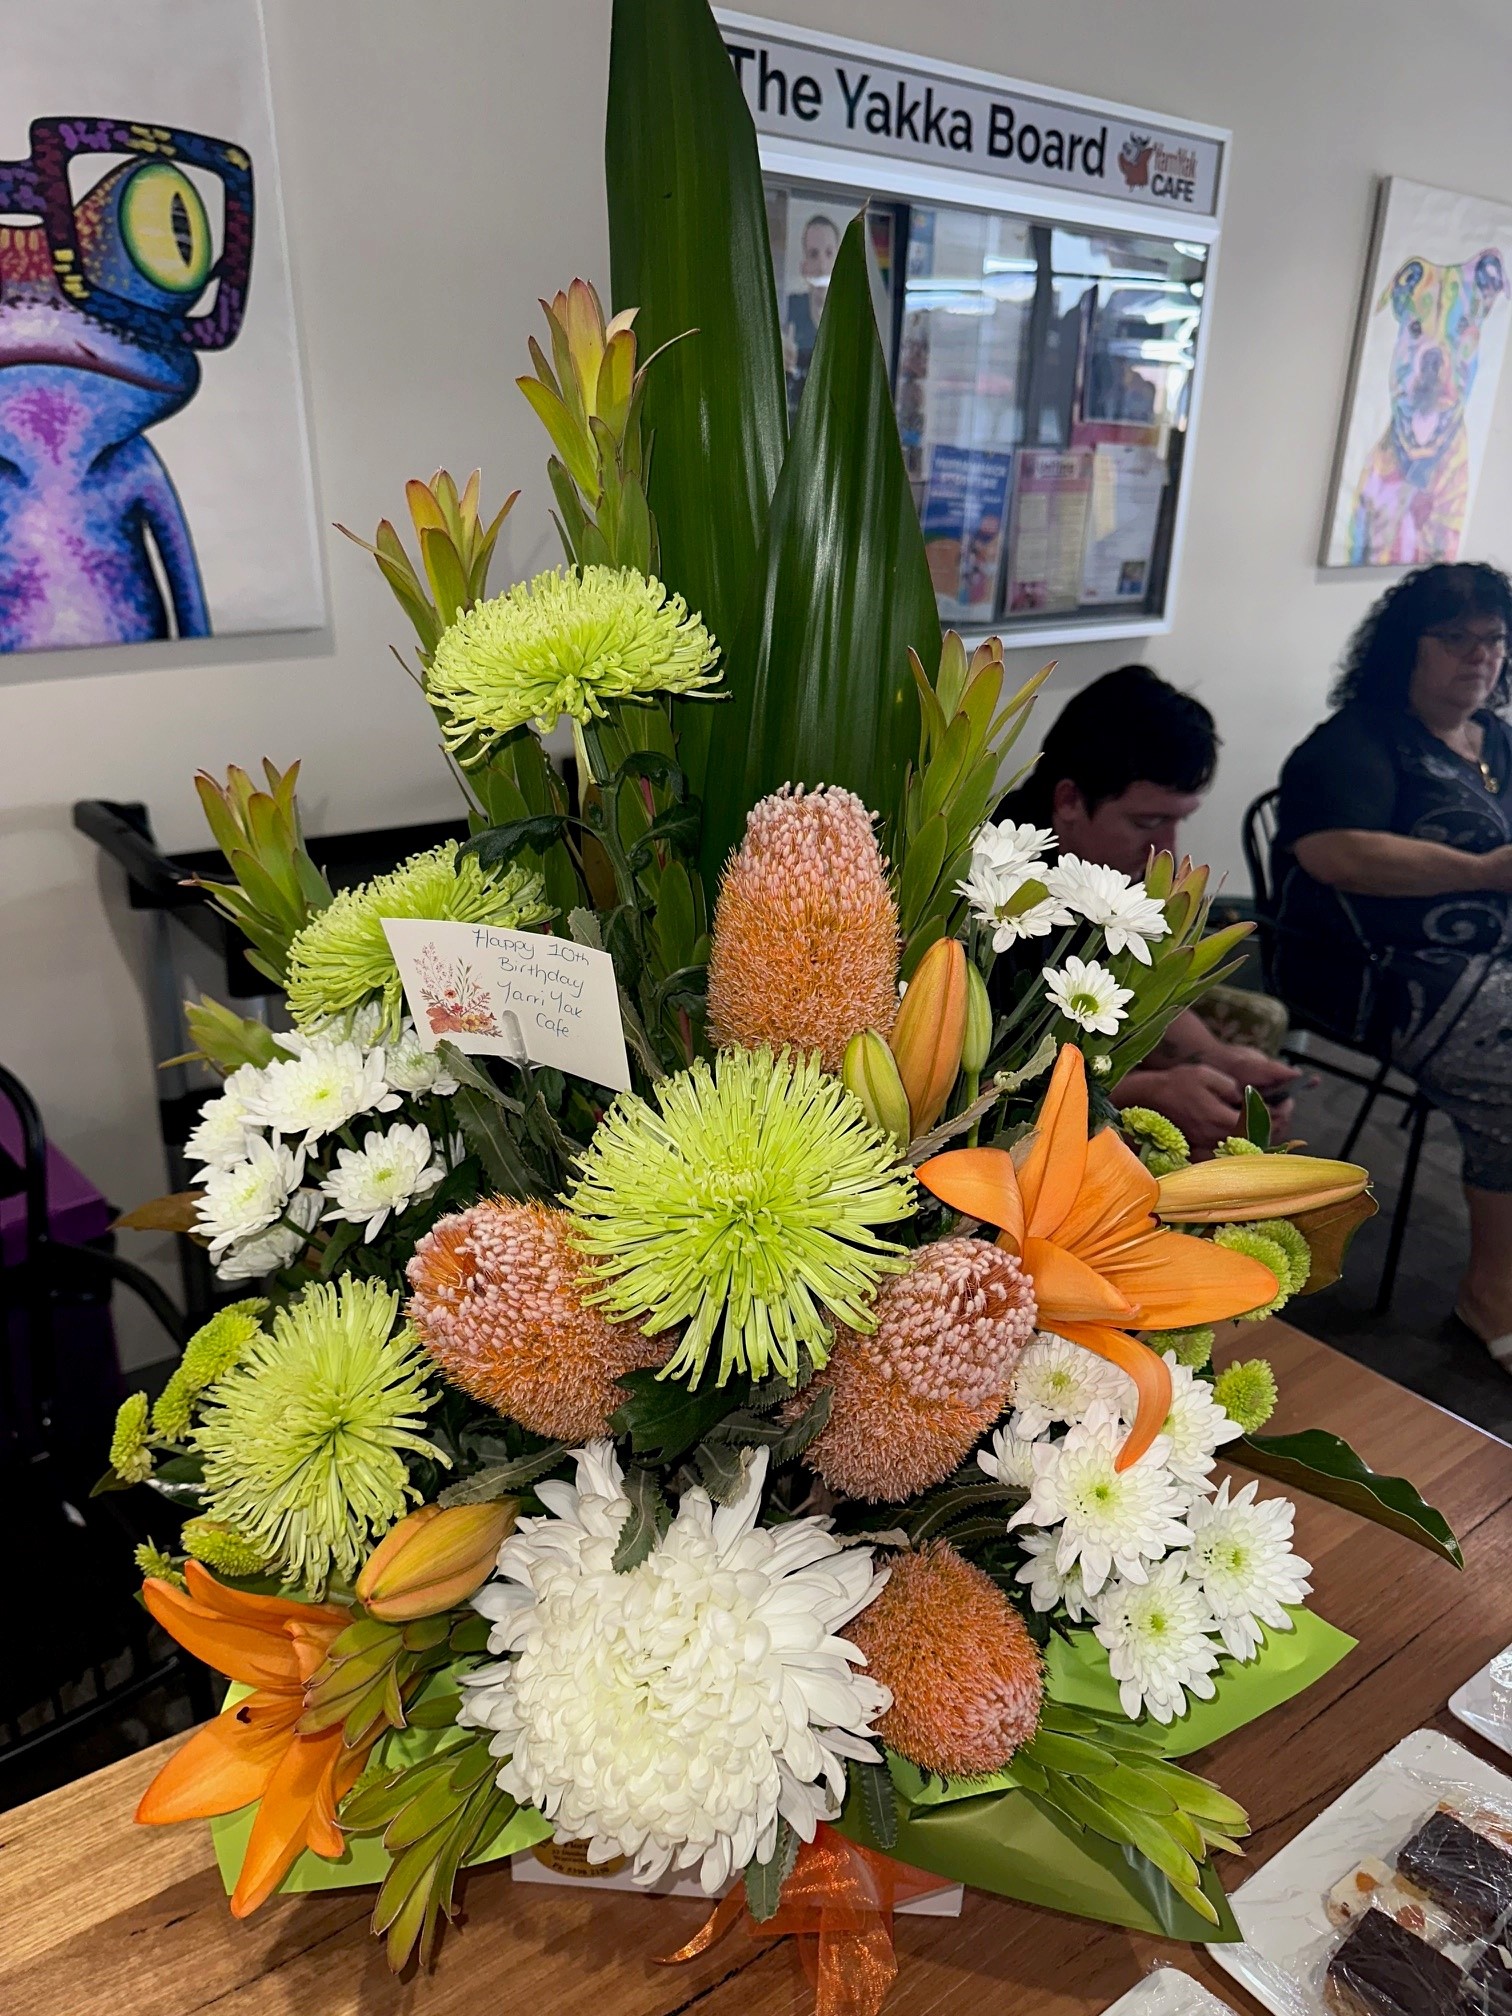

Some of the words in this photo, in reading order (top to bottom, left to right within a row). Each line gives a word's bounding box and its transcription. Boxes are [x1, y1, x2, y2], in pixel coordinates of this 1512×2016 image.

[726, 44, 823, 122] The
[835, 68, 973, 153] Yakka
[987, 103, 1107, 178] Board
[1151, 173, 1195, 202] CAFE
[472, 929, 535, 960] Happy
[547, 943, 589, 966] 10th
[498, 956, 584, 998] Birthday
[550, 991, 583, 1018] Yak
[536, 1012, 570, 1037] Cafe
